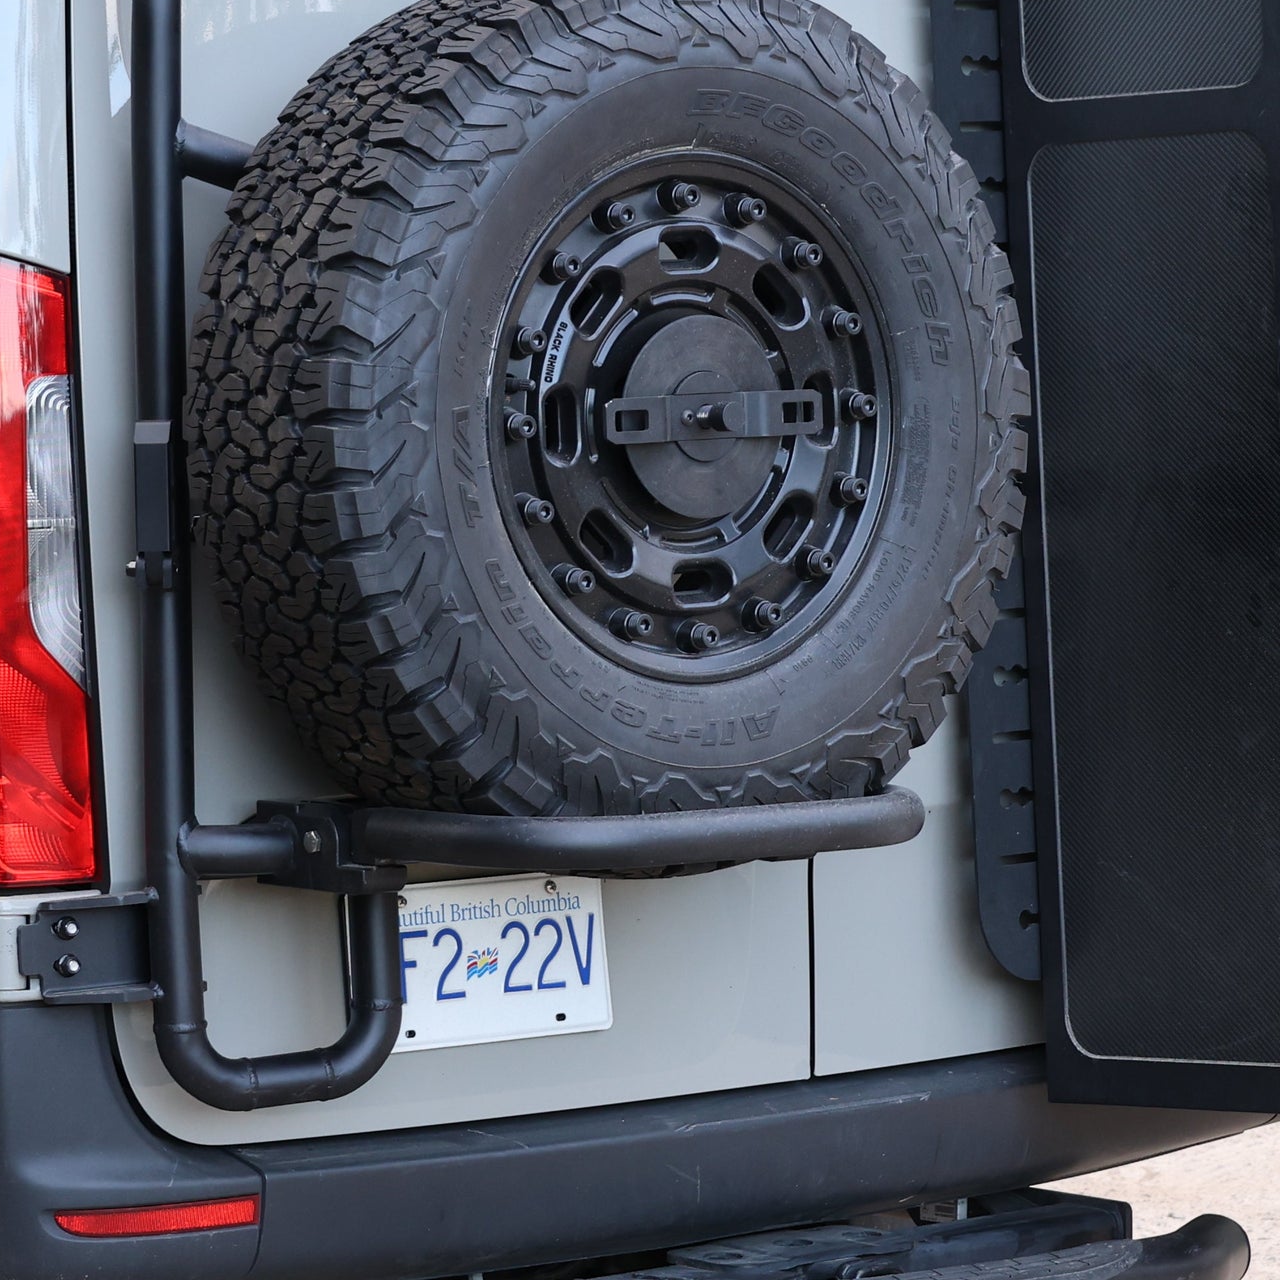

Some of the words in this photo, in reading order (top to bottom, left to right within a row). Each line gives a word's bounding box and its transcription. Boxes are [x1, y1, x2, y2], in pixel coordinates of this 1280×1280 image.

[685, 87, 955, 366] BFGoodrich
[544, 354, 558, 383] RHINO
[550, 321, 568, 352] BLACK
[451, 405, 485, 531] T/A
[485, 558, 780, 748] All-Terrain
[450, 898, 501, 923] British
[504, 892, 581, 917] Columbia
[500, 912, 595, 994] 22V
